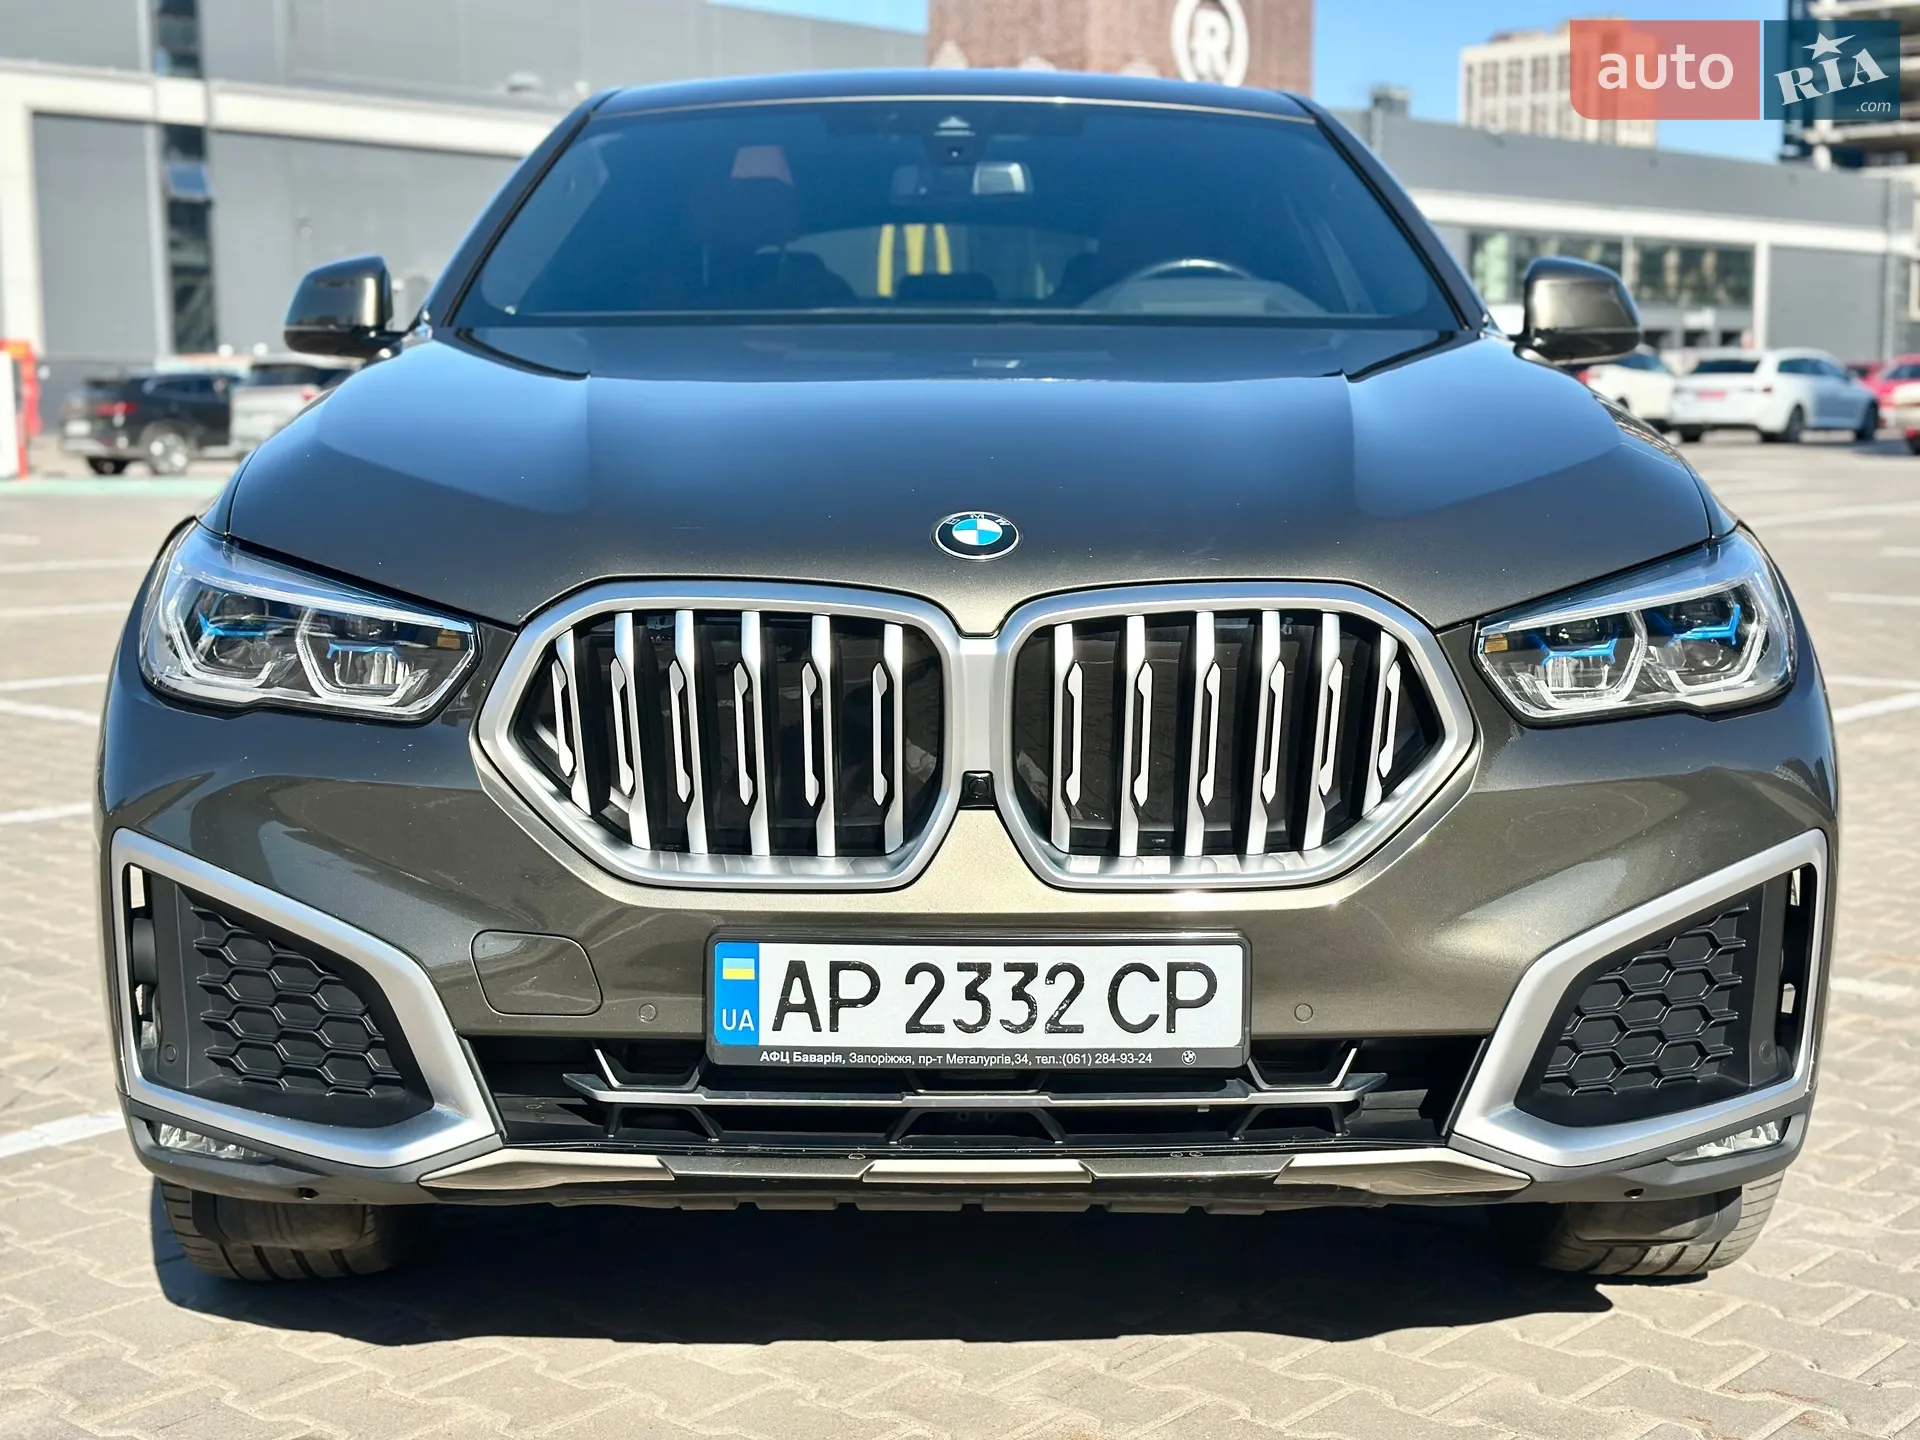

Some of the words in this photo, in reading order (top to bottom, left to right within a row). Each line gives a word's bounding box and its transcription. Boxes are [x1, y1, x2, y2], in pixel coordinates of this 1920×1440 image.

[772, 960, 881, 1033] AP
[905, 962, 1085, 1034] 2332
[1107, 962, 1218, 1034] CP
[722, 1008, 755, 1032] UA
[760, 1050, 790, 1064] АФЦ
[793, 1051, 846, 1065] Баварія,
[849, 1052, 915, 1066] Запоріжжя,
[918, 1055, 943, 1067] пр-т
[946, 1053, 1032, 1066] Металургів,34,
[1095, 1052, 1152, 1064] 284-93-24
